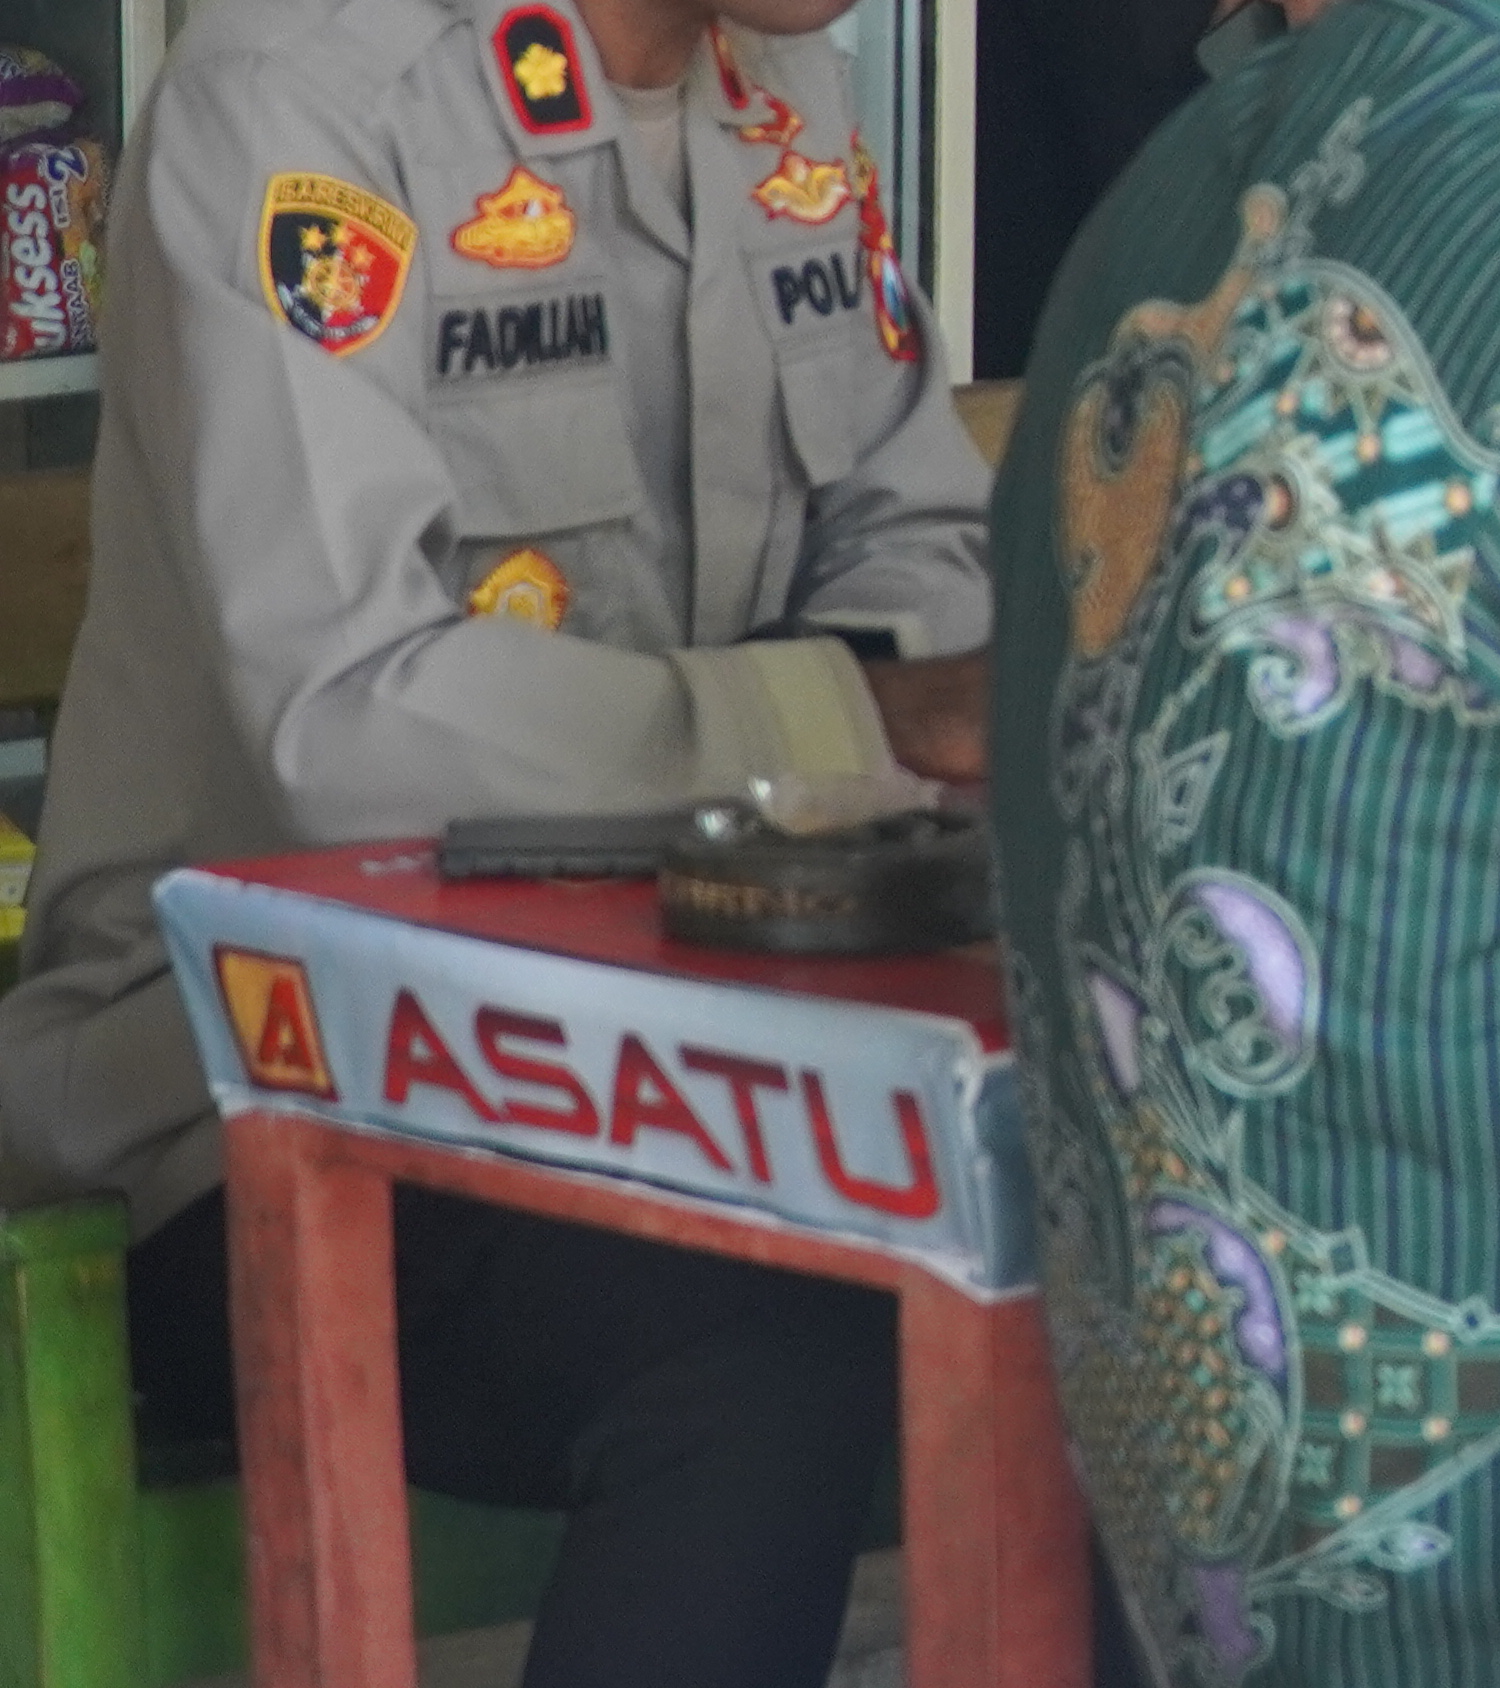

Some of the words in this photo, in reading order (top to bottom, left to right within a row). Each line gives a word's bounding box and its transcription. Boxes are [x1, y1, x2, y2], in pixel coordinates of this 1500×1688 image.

[5, 180, 68, 349] uksess
[438, 295, 611, 376] FADILLAH
[382, 987, 941, 1221] ASATU
